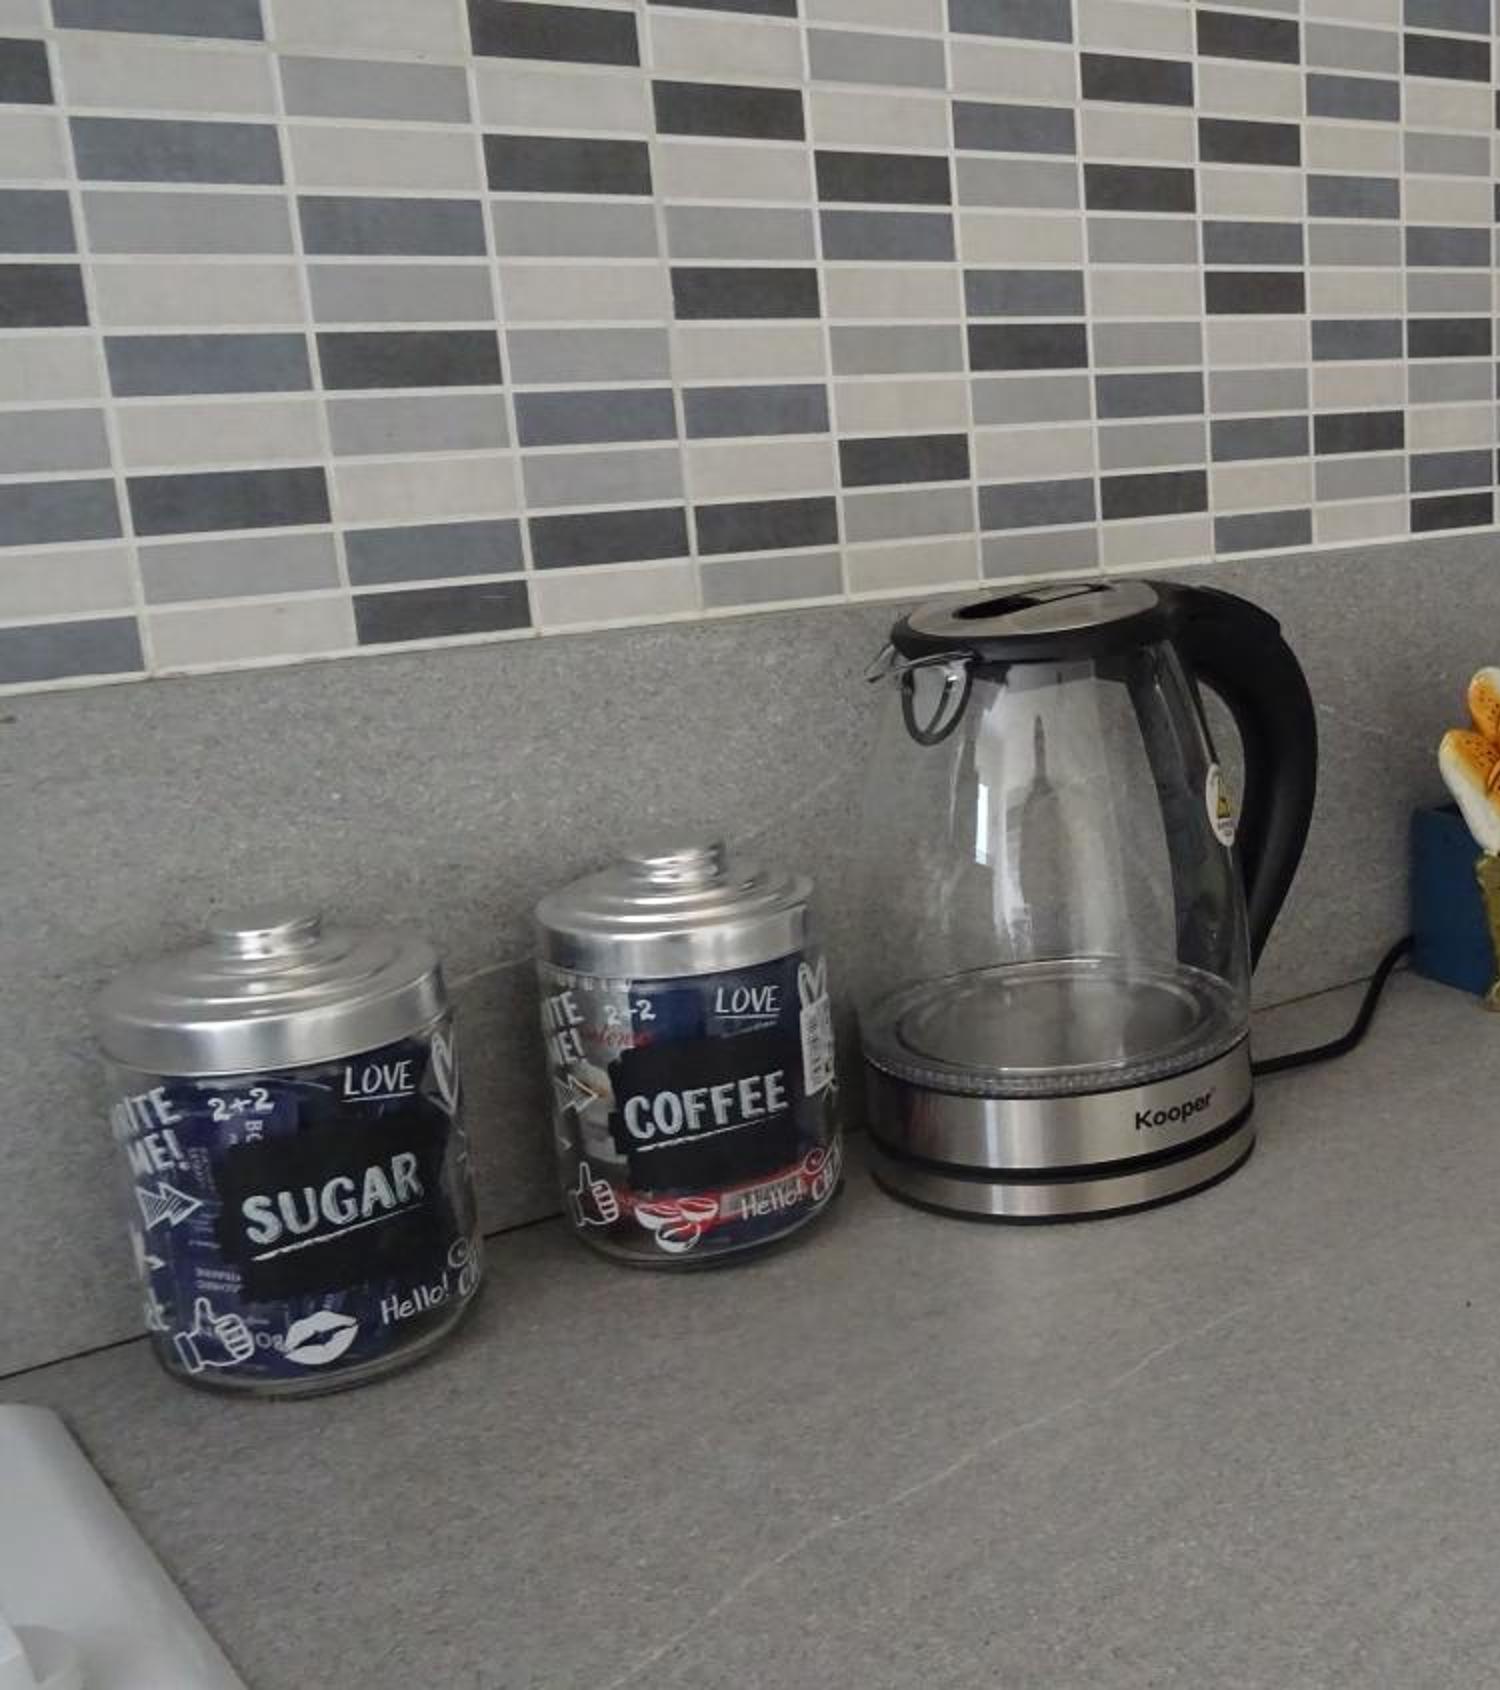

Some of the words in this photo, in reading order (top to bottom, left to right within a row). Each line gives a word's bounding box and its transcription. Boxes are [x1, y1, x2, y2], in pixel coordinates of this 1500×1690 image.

[716, 986, 782, 1014] LOVE
[344, 1060, 415, 1096] LOVE
[207, 1087, 275, 1123] 2+2
[624, 1069, 790, 1140] COFFEE
[1134, 1090, 1212, 1131] Kooper
[241, 1151, 425, 1246] SUGAR
[380, 1270, 449, 1326] Hello!
